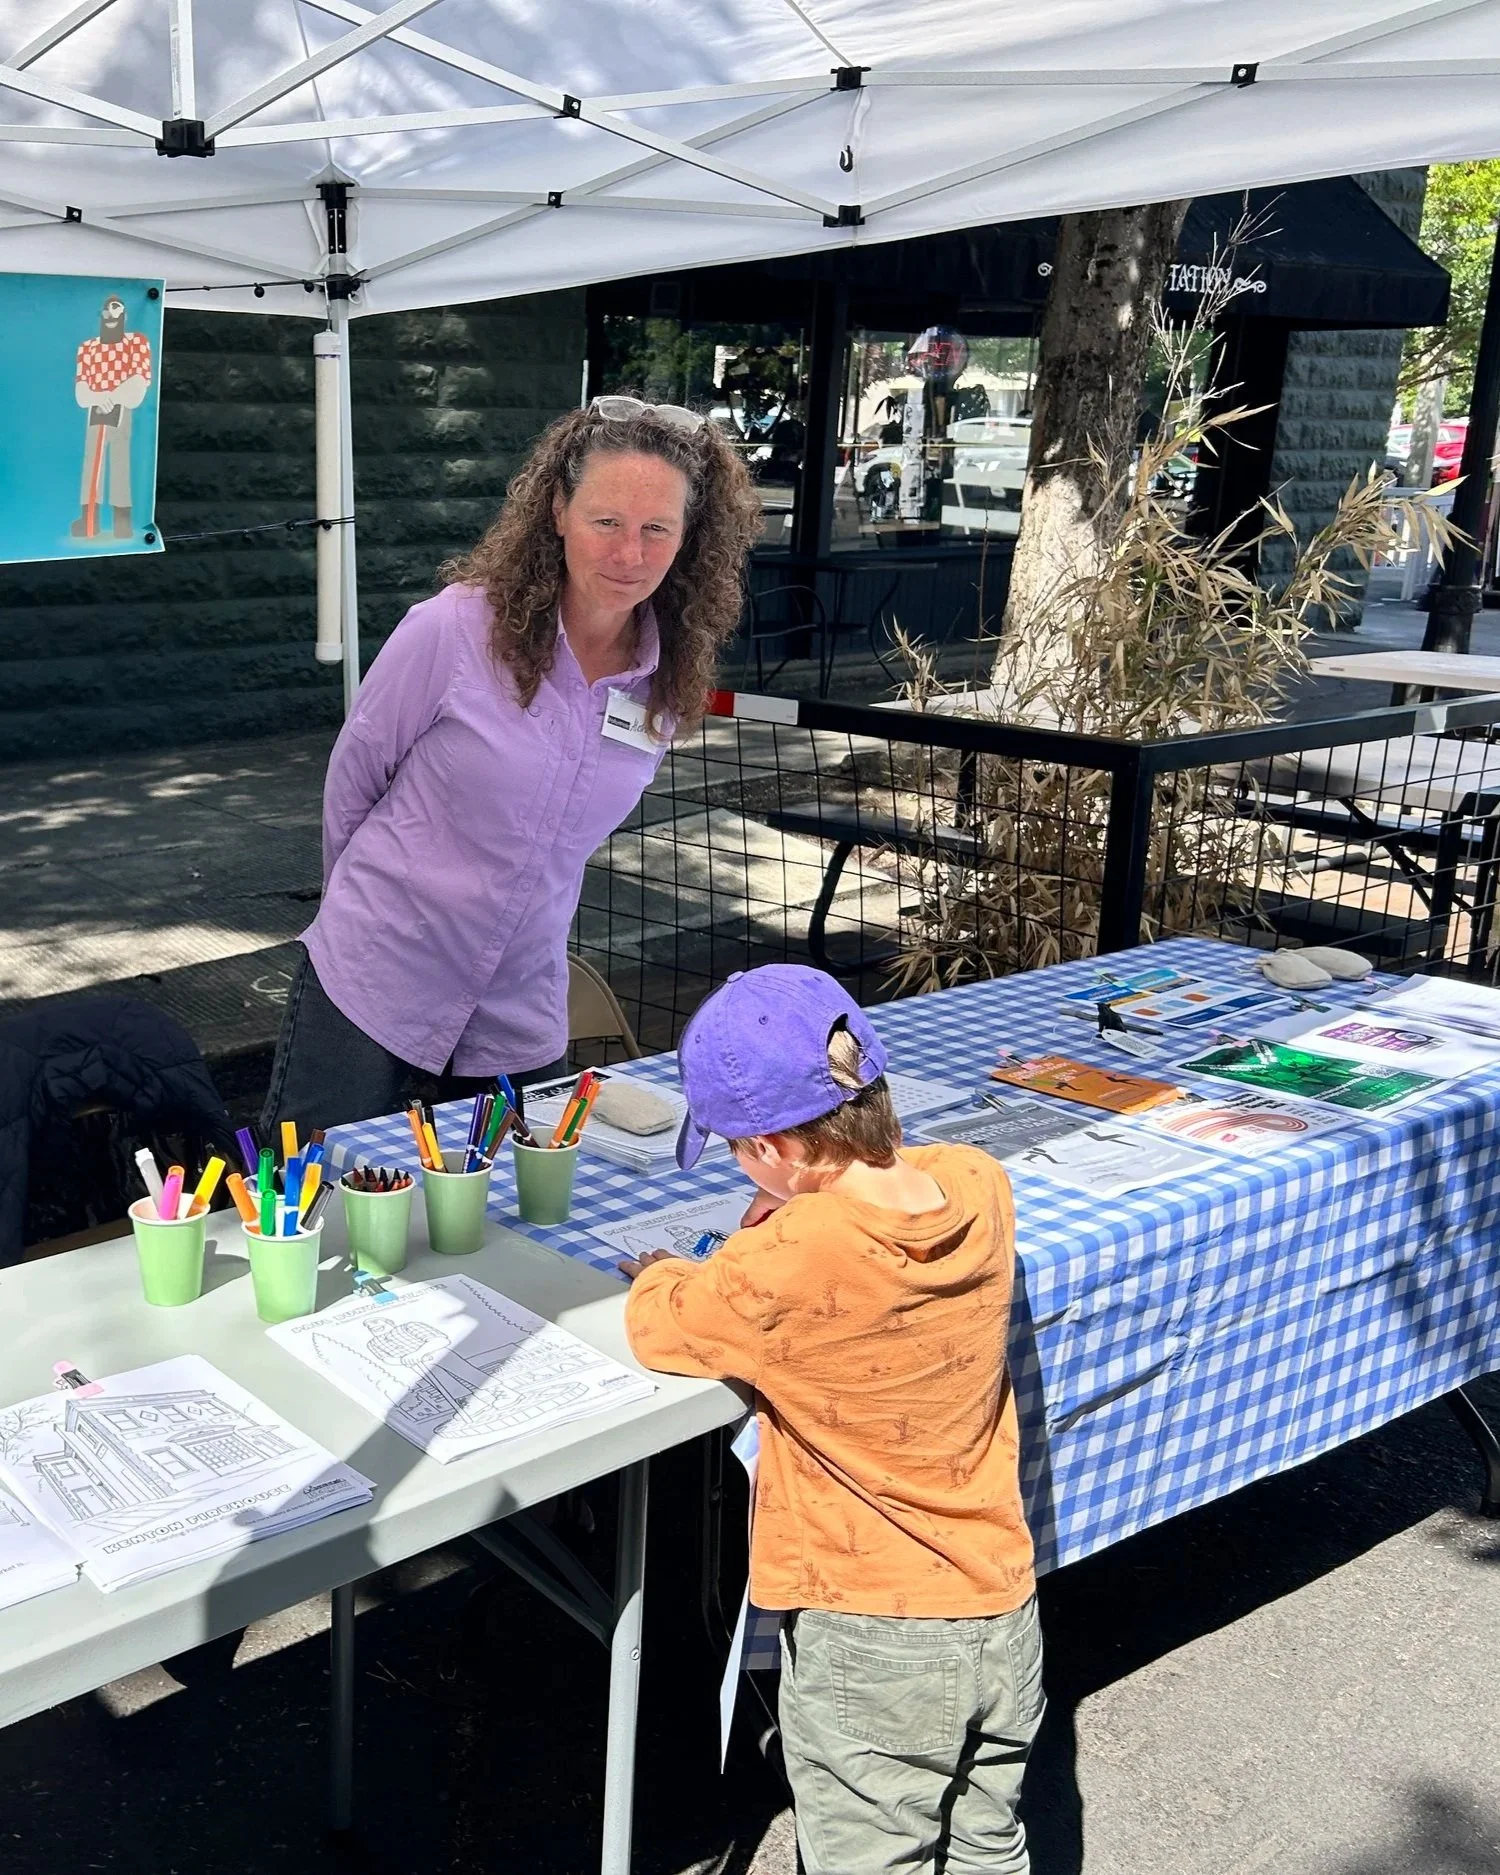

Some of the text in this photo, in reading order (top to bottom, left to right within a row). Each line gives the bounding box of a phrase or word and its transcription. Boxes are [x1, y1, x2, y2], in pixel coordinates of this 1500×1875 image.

[1164, 264, 1232, 294] TATION
[102, 1521, 184, 1554] KENTON
[185, 1484, 292, 1525] FIREHOUSE
